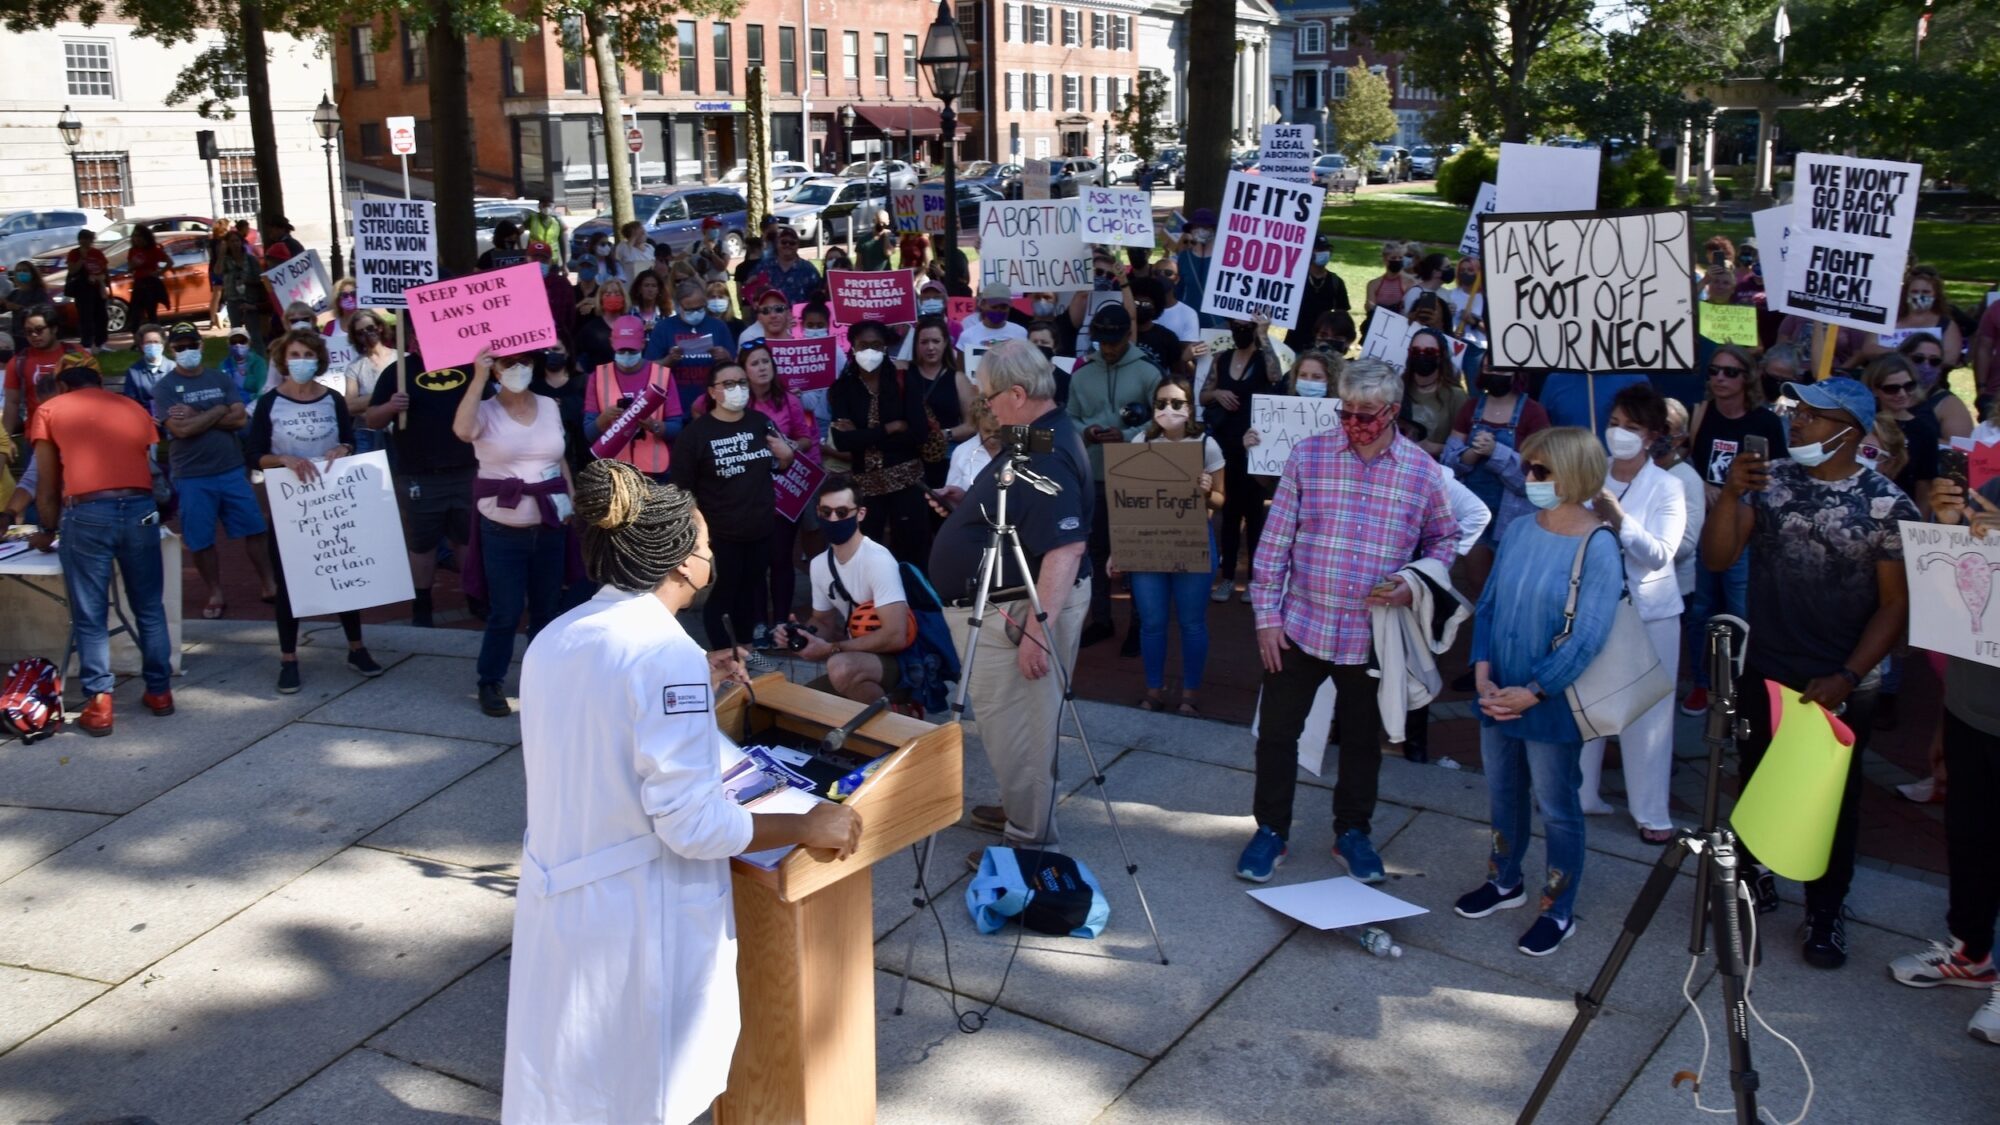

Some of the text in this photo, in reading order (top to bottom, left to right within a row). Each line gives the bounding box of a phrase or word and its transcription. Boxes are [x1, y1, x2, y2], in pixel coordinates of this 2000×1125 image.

[1275, 128, 1301, 138] SAFE
[1270, 140, 1304, 150] LEGAL
[1264, 151, 1310, 159] ABORTION
[1260, 164, 1310, 173] ON DEMAND
[1810, 163, 1910, 195] WE WON'T
[895, 194, 945, 213] MY BOD
[1089, 190, 1114, 205] ASK
[1233, 181, 1313, 223] IF IT'S
[1813, 186, 1898, 217] GO BACK
[362, 203, 425, 218] ONLY THE
[1121, 208, 1142, 219] MY
[359, 219, 430, 235] STRUGGLE
[898, 215, 919, 232] MY
[982, 205, 1082, 238] ABORTION
[1228, 213, 1307, 244] NOT YOUR
[1811, 207, 1892, 239] WE WILL
[364, 236, 427, 252] HAS WON
[1021, 240, 1040, 257] IS
[1483, 211, 1690, 280] TAKE YOUR
[1221, 234, 1302, 279] BODY
[1809, 245, 1875, 278] FIGHT
[270, 253, 313, 286] MY BODY
[361, 259, 433, 277] WOMEN'S
[371, 277, 425, 294] RIGH
[416, 286, 458, 305] KEEP
[464, 277, 507, 296] YOUR
[837, 287, 906, 299] SAFE, LEGAL
[844, 278, 896, 289] PROTECT
[1216, 270, 1295, 305] IT'S NOT
[1805, 269, 1873, 304] BACK!
[843, 297, 902, 309] ABORTION
[955, 302, 974, 313] KE
[1213, 294, 1290, 321] YOUR CHOICE
[1514, 274, 1658, 322] FOOT OFF
[430, 294, 512, 322] LAWS OFF
[457, 321, 492, 339] OUR
[490, 327, 553, 351] BODIES!
[772, 344, 822, 356] PROTECT
[1502, 317, 1694, 371] OUR NECK
[775, 363, 826, 374] BORTION
[797, 353, 830, 365] LEGAL
[600, 397, 649, 445] ABORTION
[1252, 397, 1288, 433] Fight
[1292, 402, 1307, 425] 4
[710, 431, 754, 450] pumpkin
[713, 440, 749, 458] spice &
[337, 467, 368, 486] call
[716, 464, 746, 479] rights
[786, 468, 811, 492] LEGAL
[297, 485, 357, 517] yourself
[1156, 487, 1201, 519] Forget
[311, 520, 356, 537] if you
[1908, 527, 1942, 546] MIND
[313, 545, 356, 562] value
[315, 555, 376, 576] certain
[330, 577, 371, 591] lives.
[1975, 640, 2000, 658] UTE
